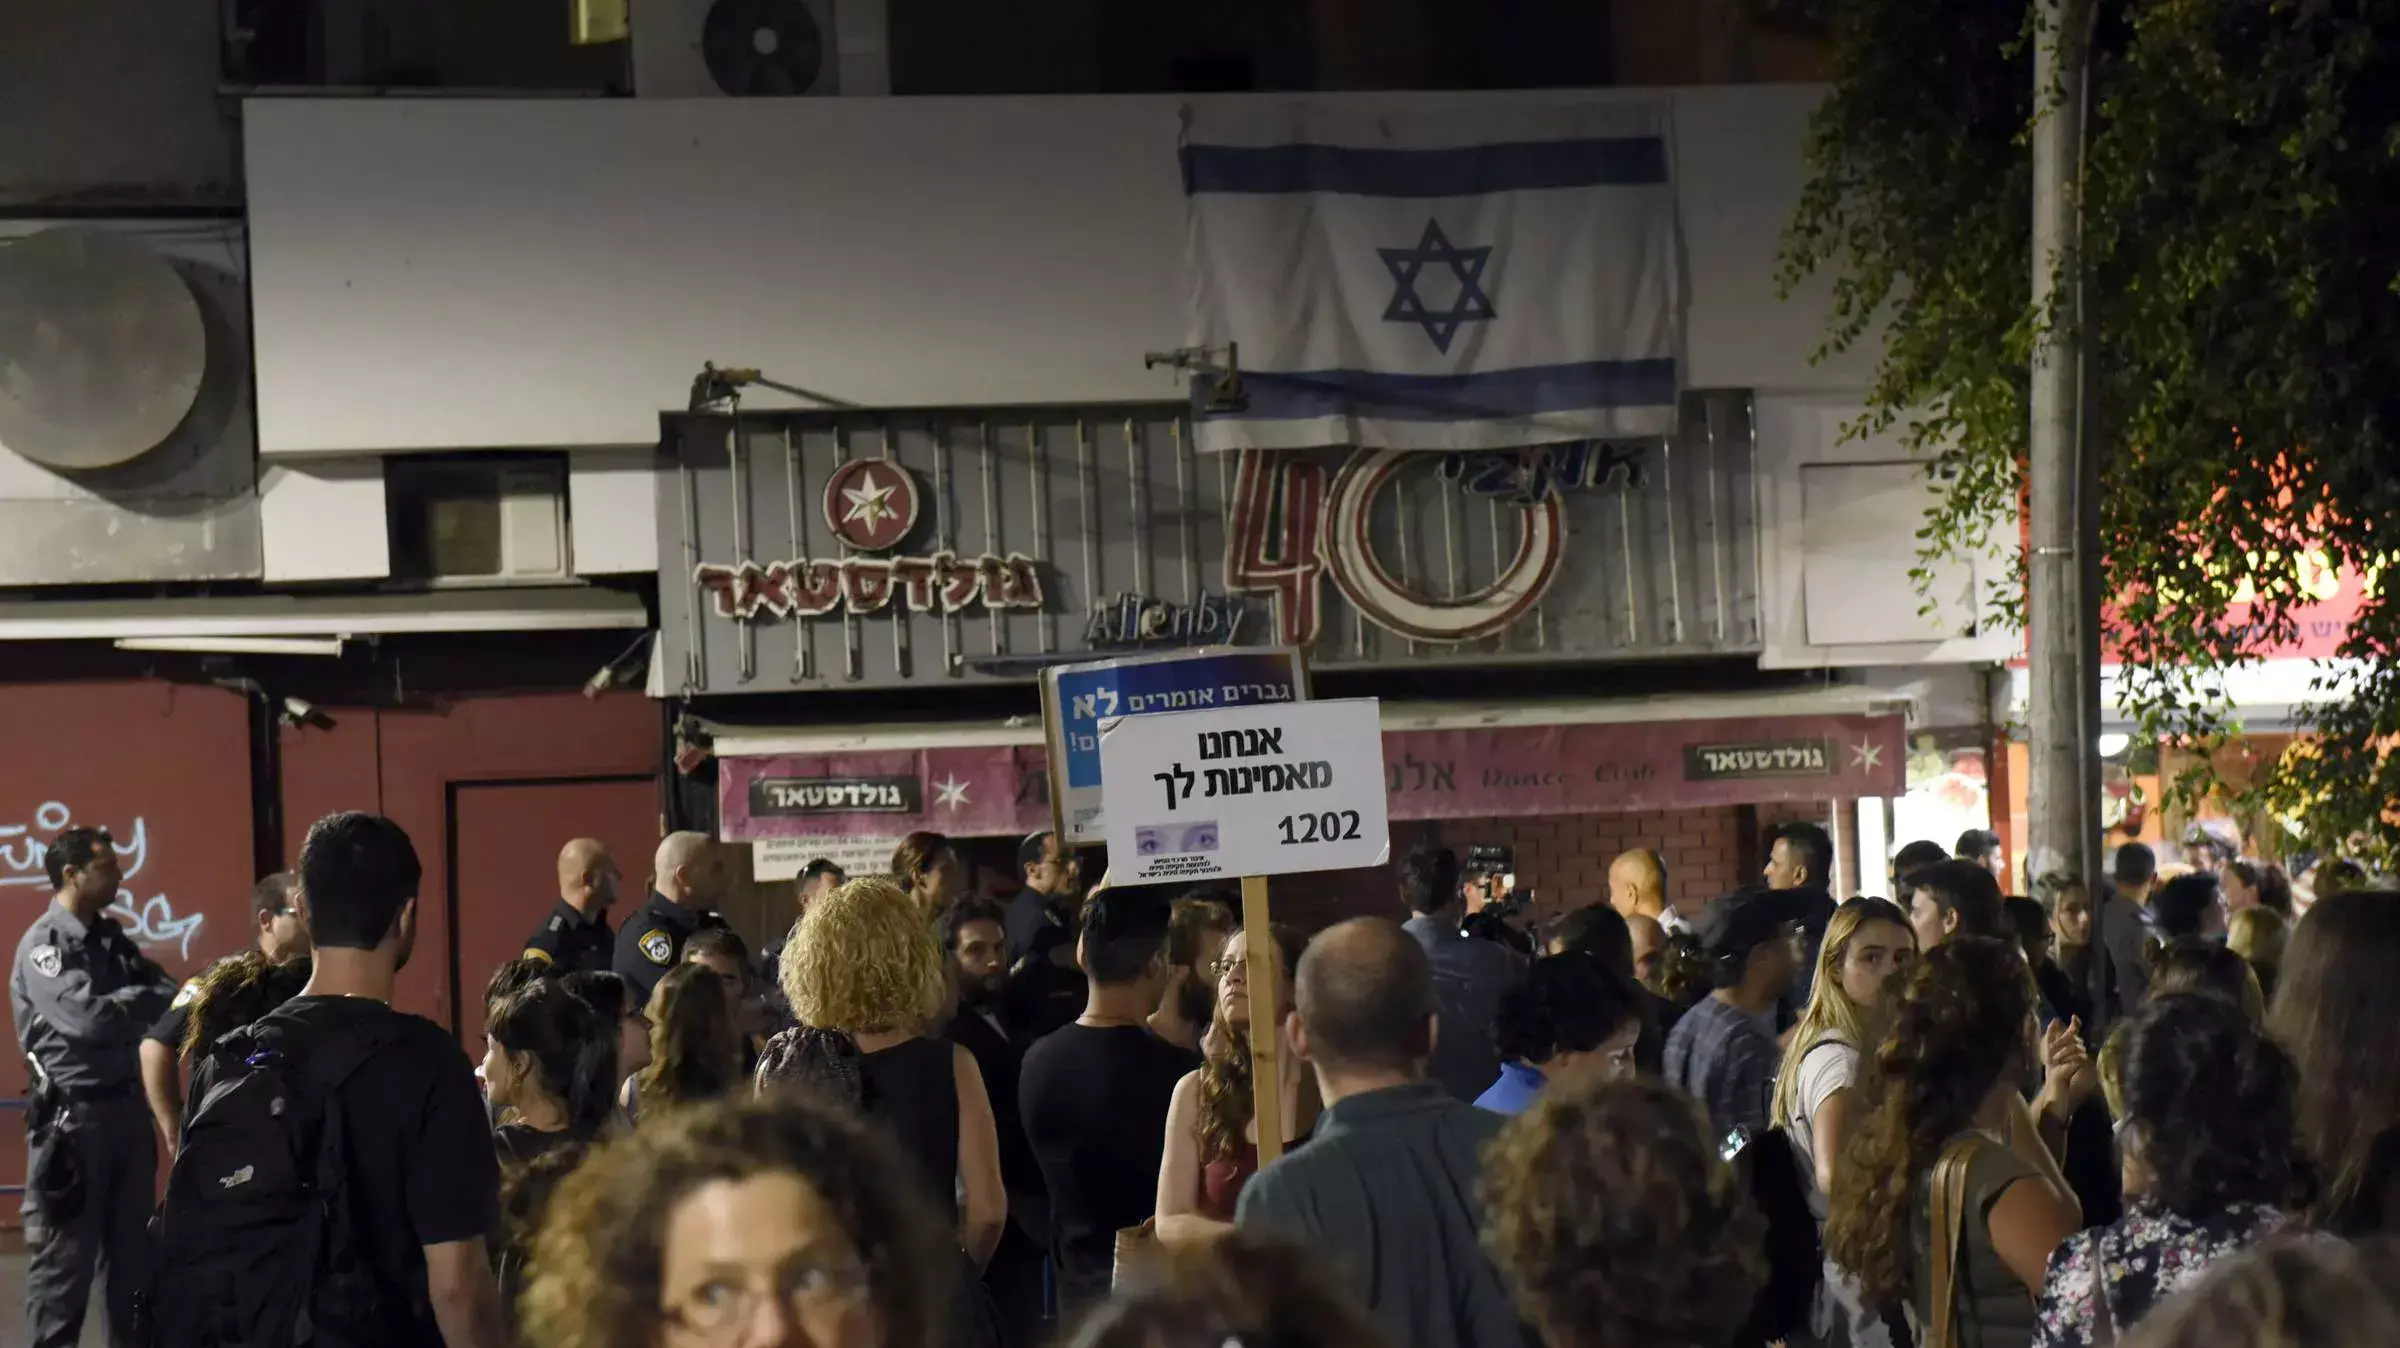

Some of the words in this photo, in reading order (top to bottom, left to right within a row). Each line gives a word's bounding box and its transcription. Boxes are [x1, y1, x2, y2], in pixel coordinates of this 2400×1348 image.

[1224, 448, 1569, 644] 40
[1086, 590, 1244, 647] Allenby
[1072, 686, 1119, 720] לא
[1127, 687, 1214, 712] אומרים
[1221, 682, 1291, 701] גברים
[1197, 726, 1283, 760] אנחנו
[1153, 763, 1195, 810] לך
[1204, 760, 1333, 797] מאמינות
[1277, 810, 1361, 845] 1202
